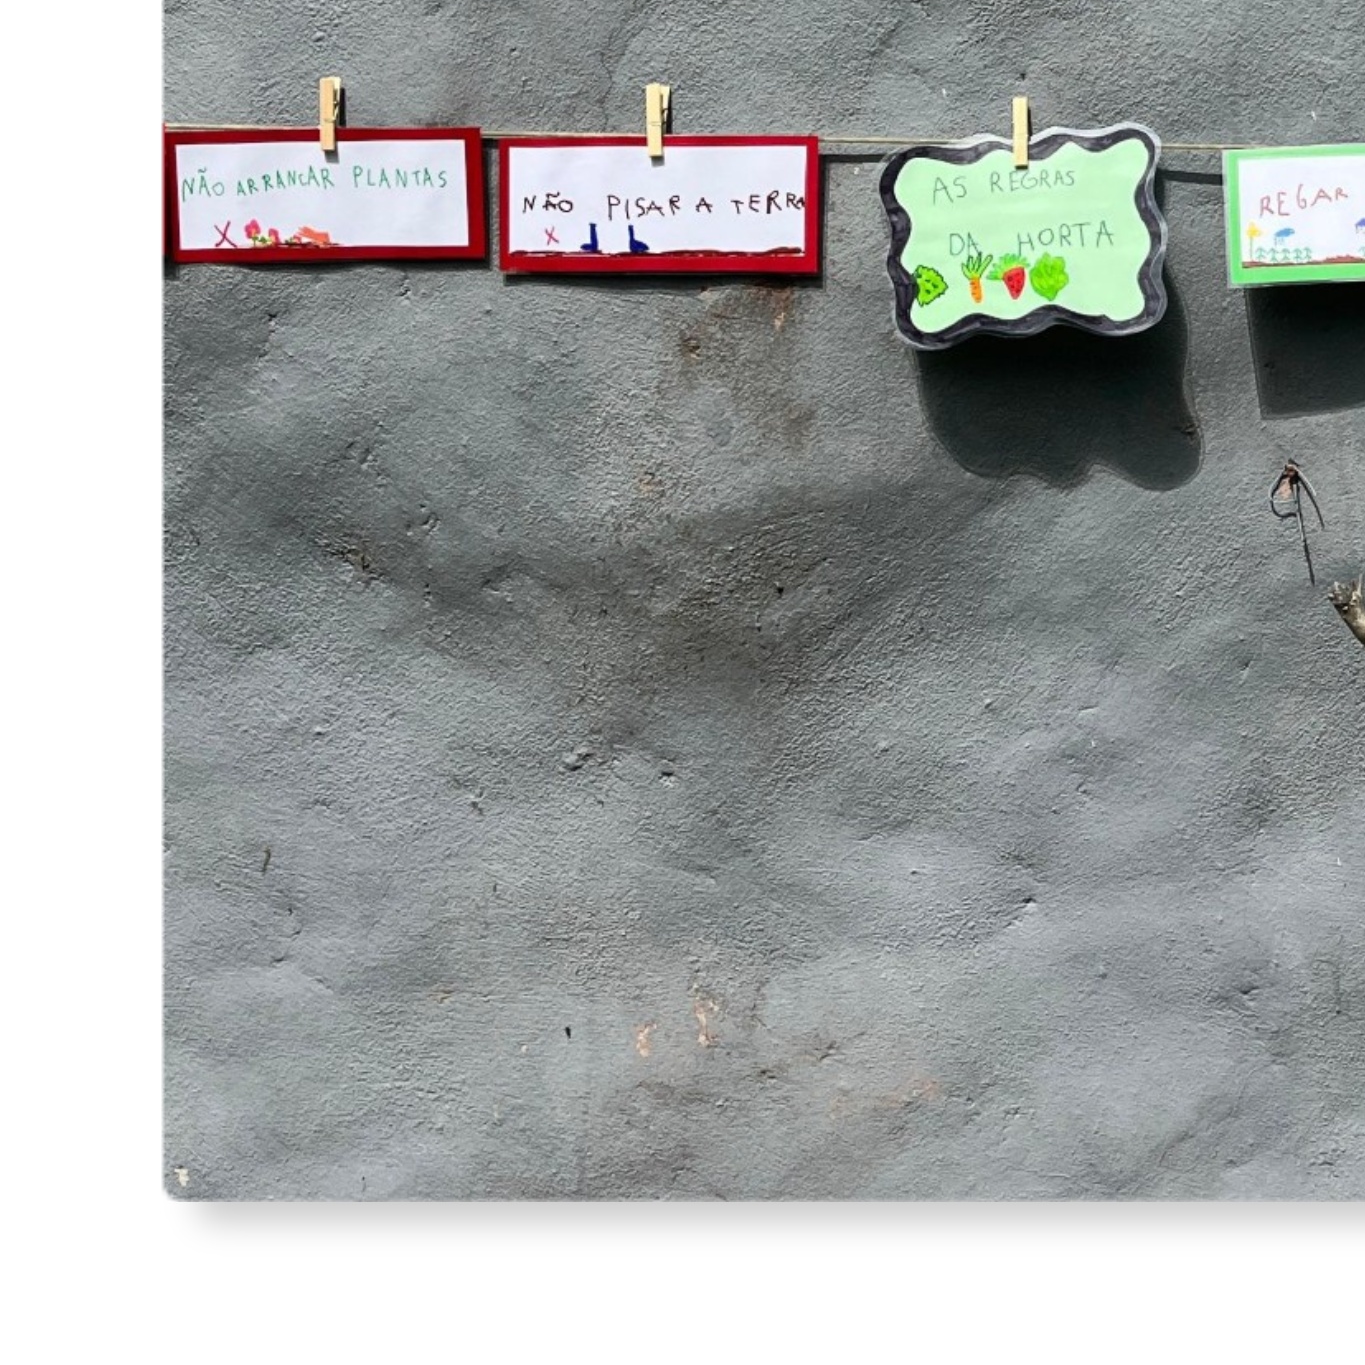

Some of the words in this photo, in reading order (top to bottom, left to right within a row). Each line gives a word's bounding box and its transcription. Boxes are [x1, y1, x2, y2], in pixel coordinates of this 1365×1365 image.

[181, 168, 225, 202] NÃO
[236, 164, 335, 198] ARRANCAR
[352, 165, 448, 190] PLANTAS
[932, 175, 968, 205] AS
[989, 169, 1076, 194] REGRAS
[1258, 183, 1349, 218] REGAR
[522, 192, 574, 214] NÃO
[606, 194, 682, 222] PISAR
[695, 196, 713, 213] A
[730, 190, 806, 215] TERRA
[949, 231, 983, 256] DA
[1016, 220, 1115, 257] HORTA
